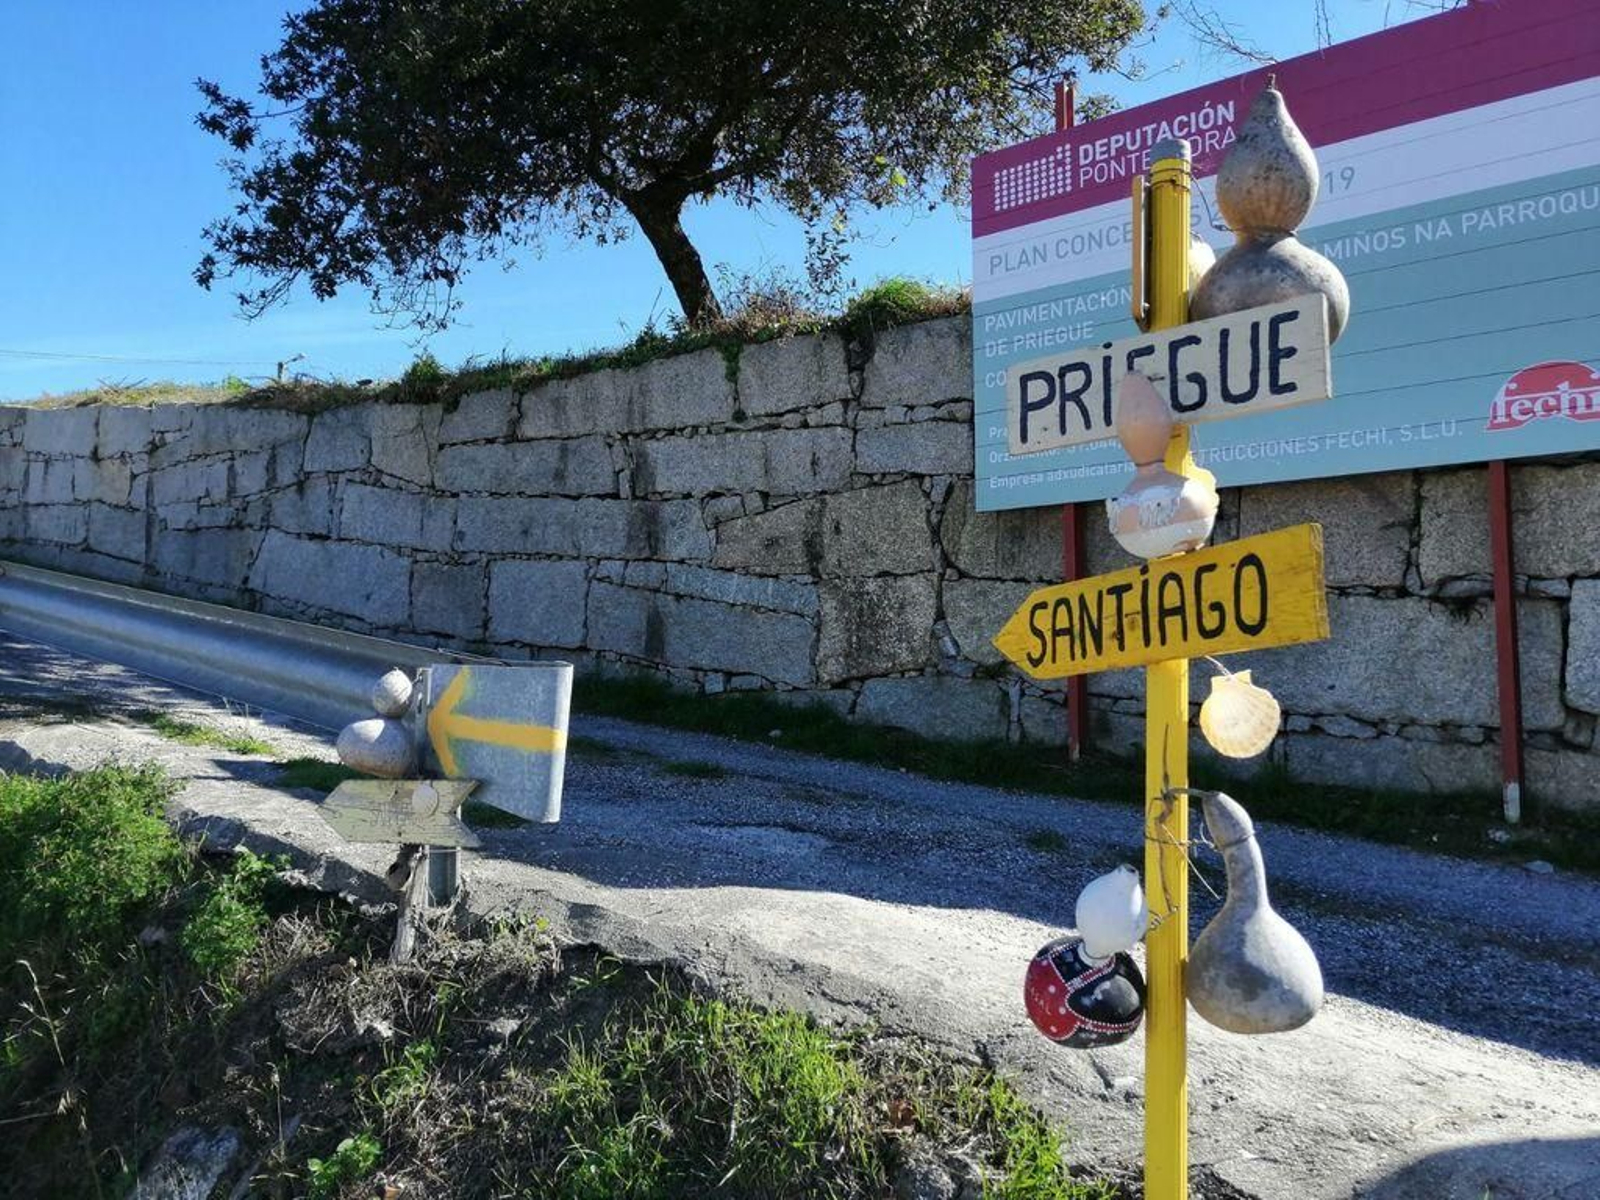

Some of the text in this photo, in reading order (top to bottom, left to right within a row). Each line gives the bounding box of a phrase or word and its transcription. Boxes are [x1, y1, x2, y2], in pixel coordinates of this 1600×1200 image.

[1078, 100, 1236, 167] DEPUTACIÓN
[1079, 126, 1237, 188] PONTEDRA
[984, 283, 1132, 333] PAVIMENTACIÓN
[1312, 226, 1406, 262] MIÑOS
[1414, 218, 1454, 246] NA
[989, 243, 1047, 276] PLAN
[985, 321, 1095, 359] DE PRIEGUE
[989, 470, 1044, 490] Empresa
[1191, 435, 1319, 466] TRUCCIONES
[1400, 419, 1464, 442] S.L.U.
[1026, 553, 1269, 668] SANTIAGO
